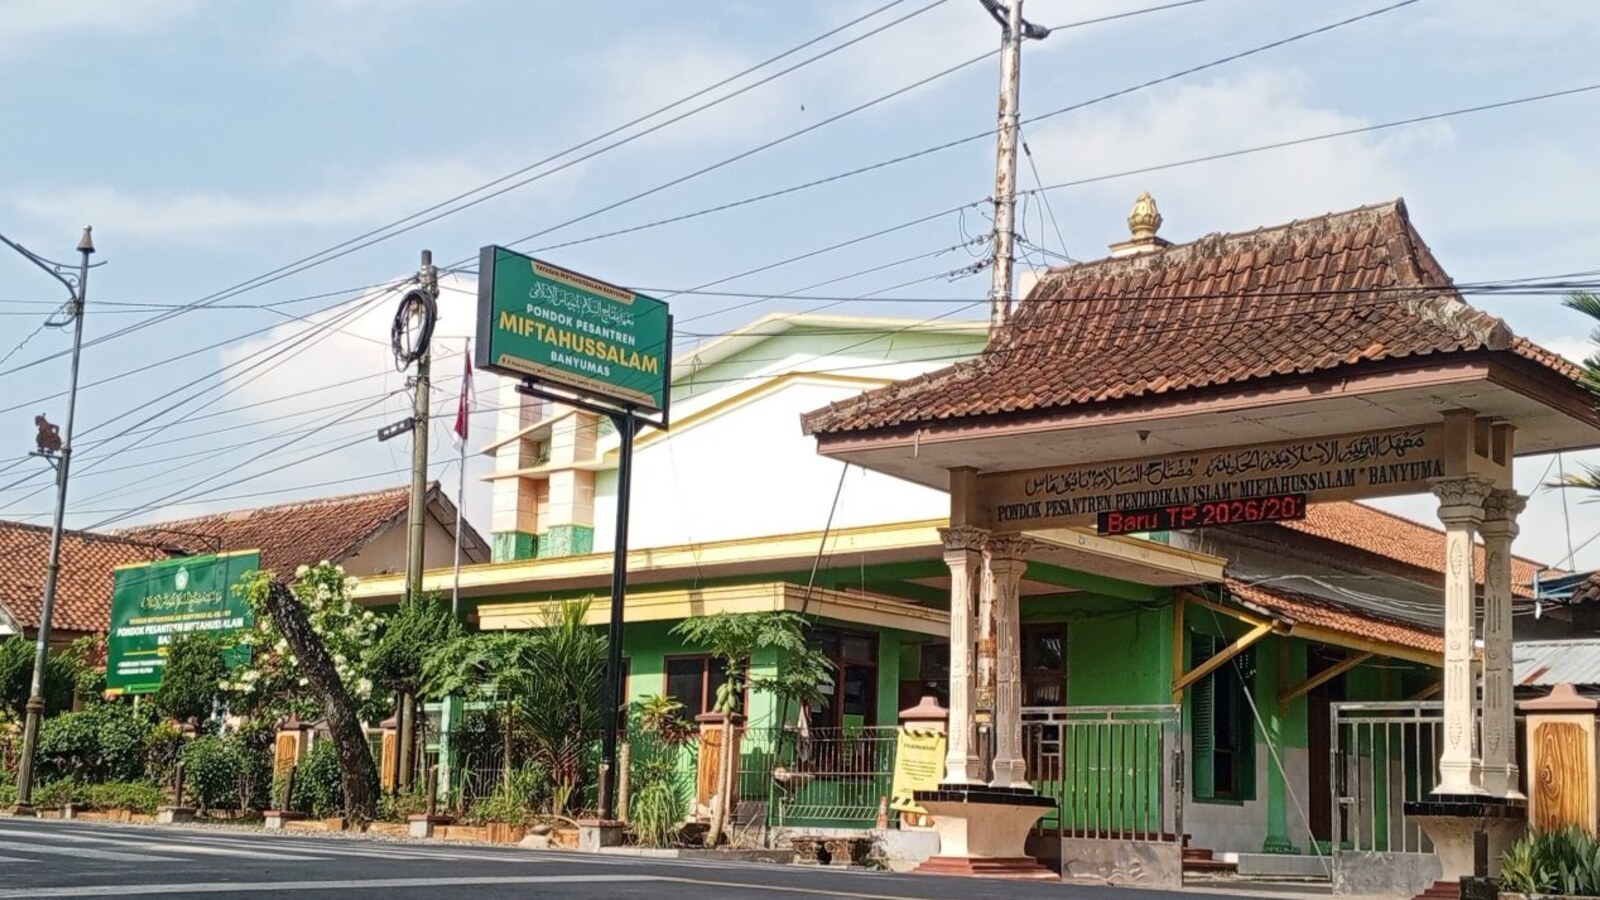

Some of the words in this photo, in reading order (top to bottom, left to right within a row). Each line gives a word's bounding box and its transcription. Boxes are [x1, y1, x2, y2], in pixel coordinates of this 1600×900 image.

[498, 310, 659, 375] MIFTAHUSSALAM
[526, 303, 573, 327] PONDOK
[576, 319, 636, 346] PESANTREN
[550, 351, 611, 377] BANYUMAS
[997, 500, 1042, 523] PONDOK
[1045, 494, 1112, 517] PESANTREN
[1115, 486, 1191, 510] PENDIDIKAN
[1368, 459, 1445, 485] BANYUMA
[1107, 511, 1159, 533] Baru
